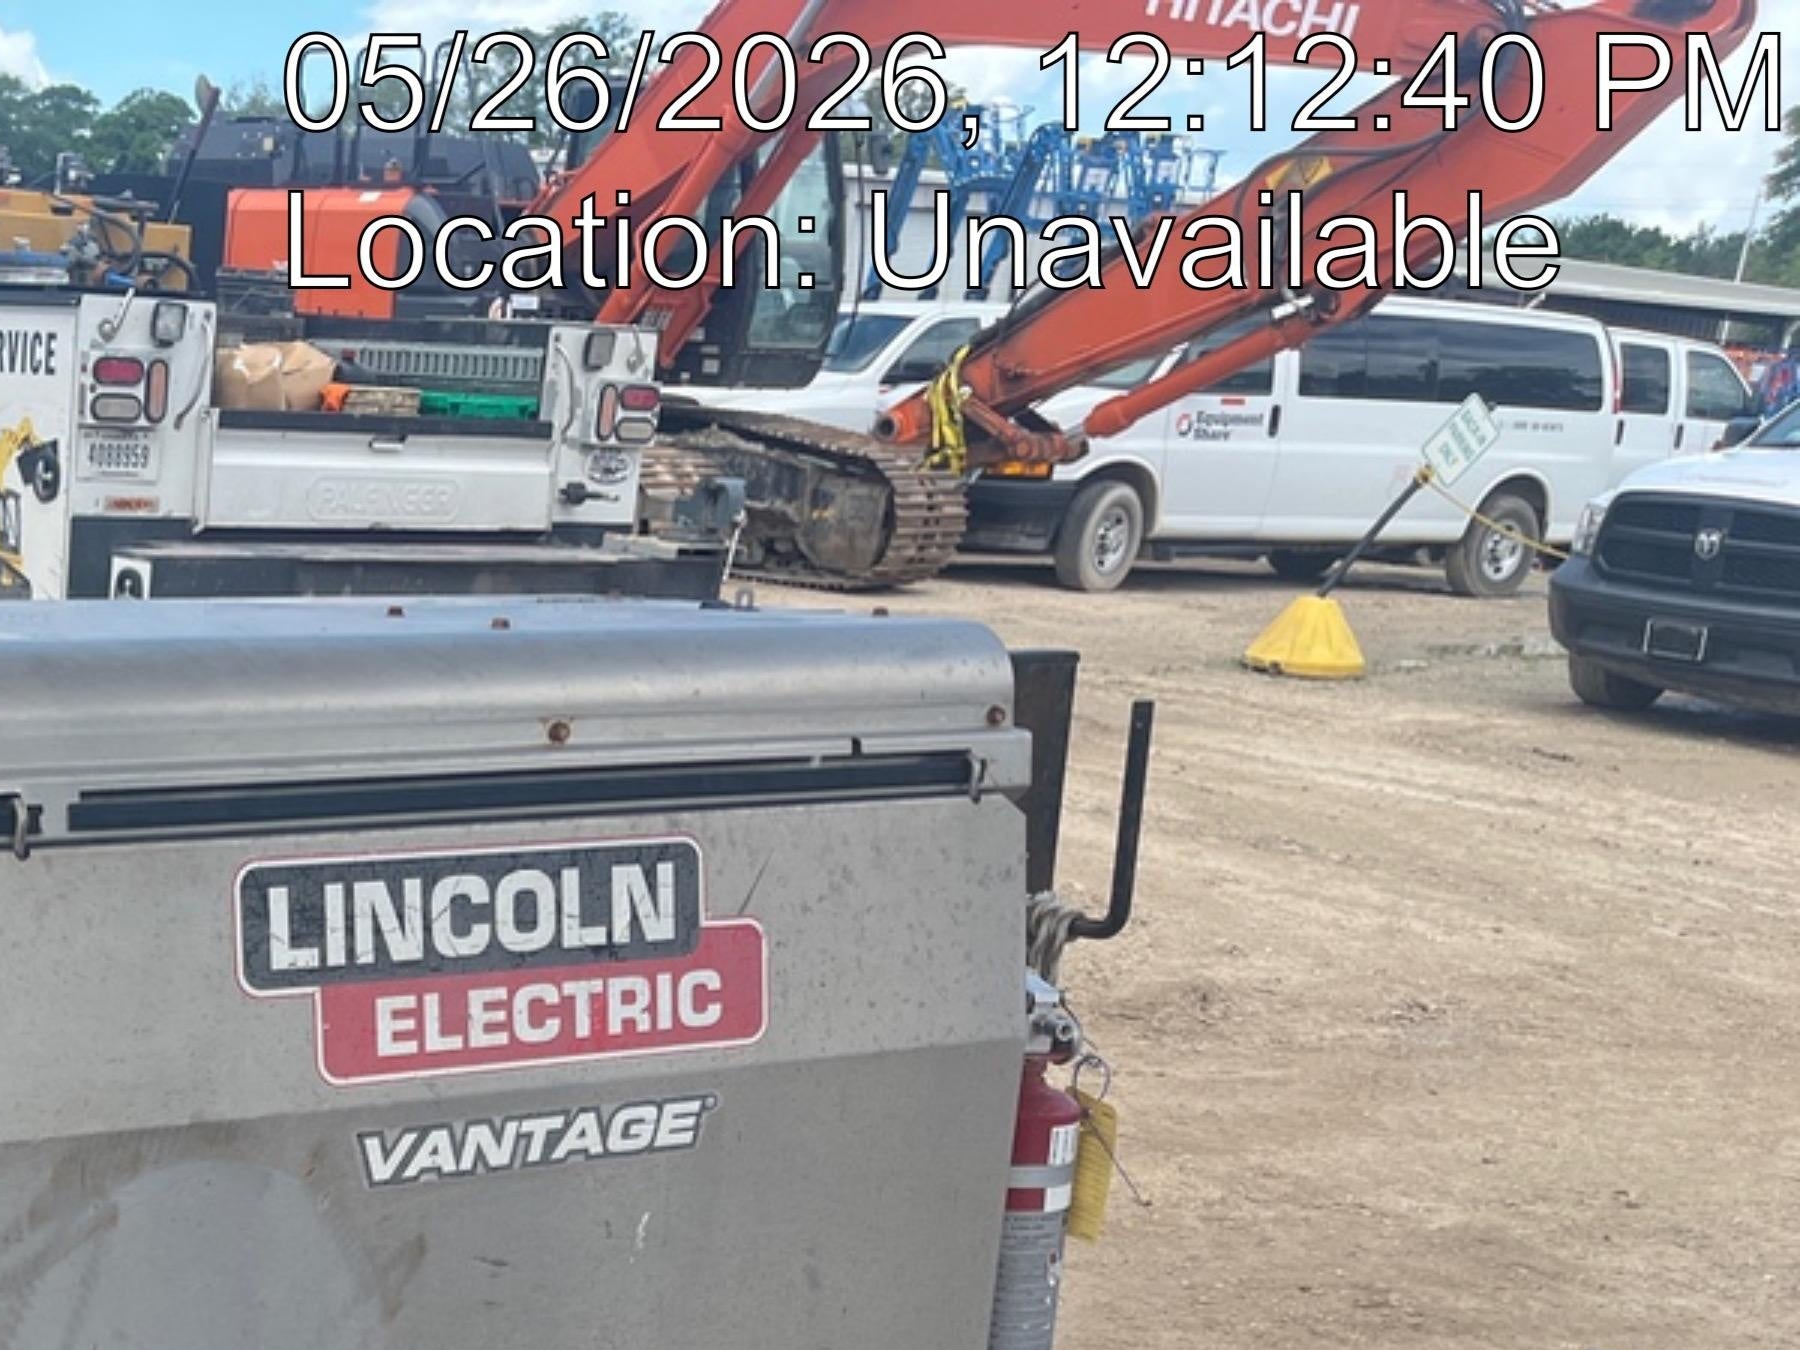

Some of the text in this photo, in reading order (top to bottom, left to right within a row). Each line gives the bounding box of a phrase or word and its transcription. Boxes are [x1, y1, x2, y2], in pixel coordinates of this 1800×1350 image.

[268, 861, 677, 972] LINCOLN
[375, 968, 722, 1057] ELECTRIC
[361, 1098, 705, 1183] VANTAGE
